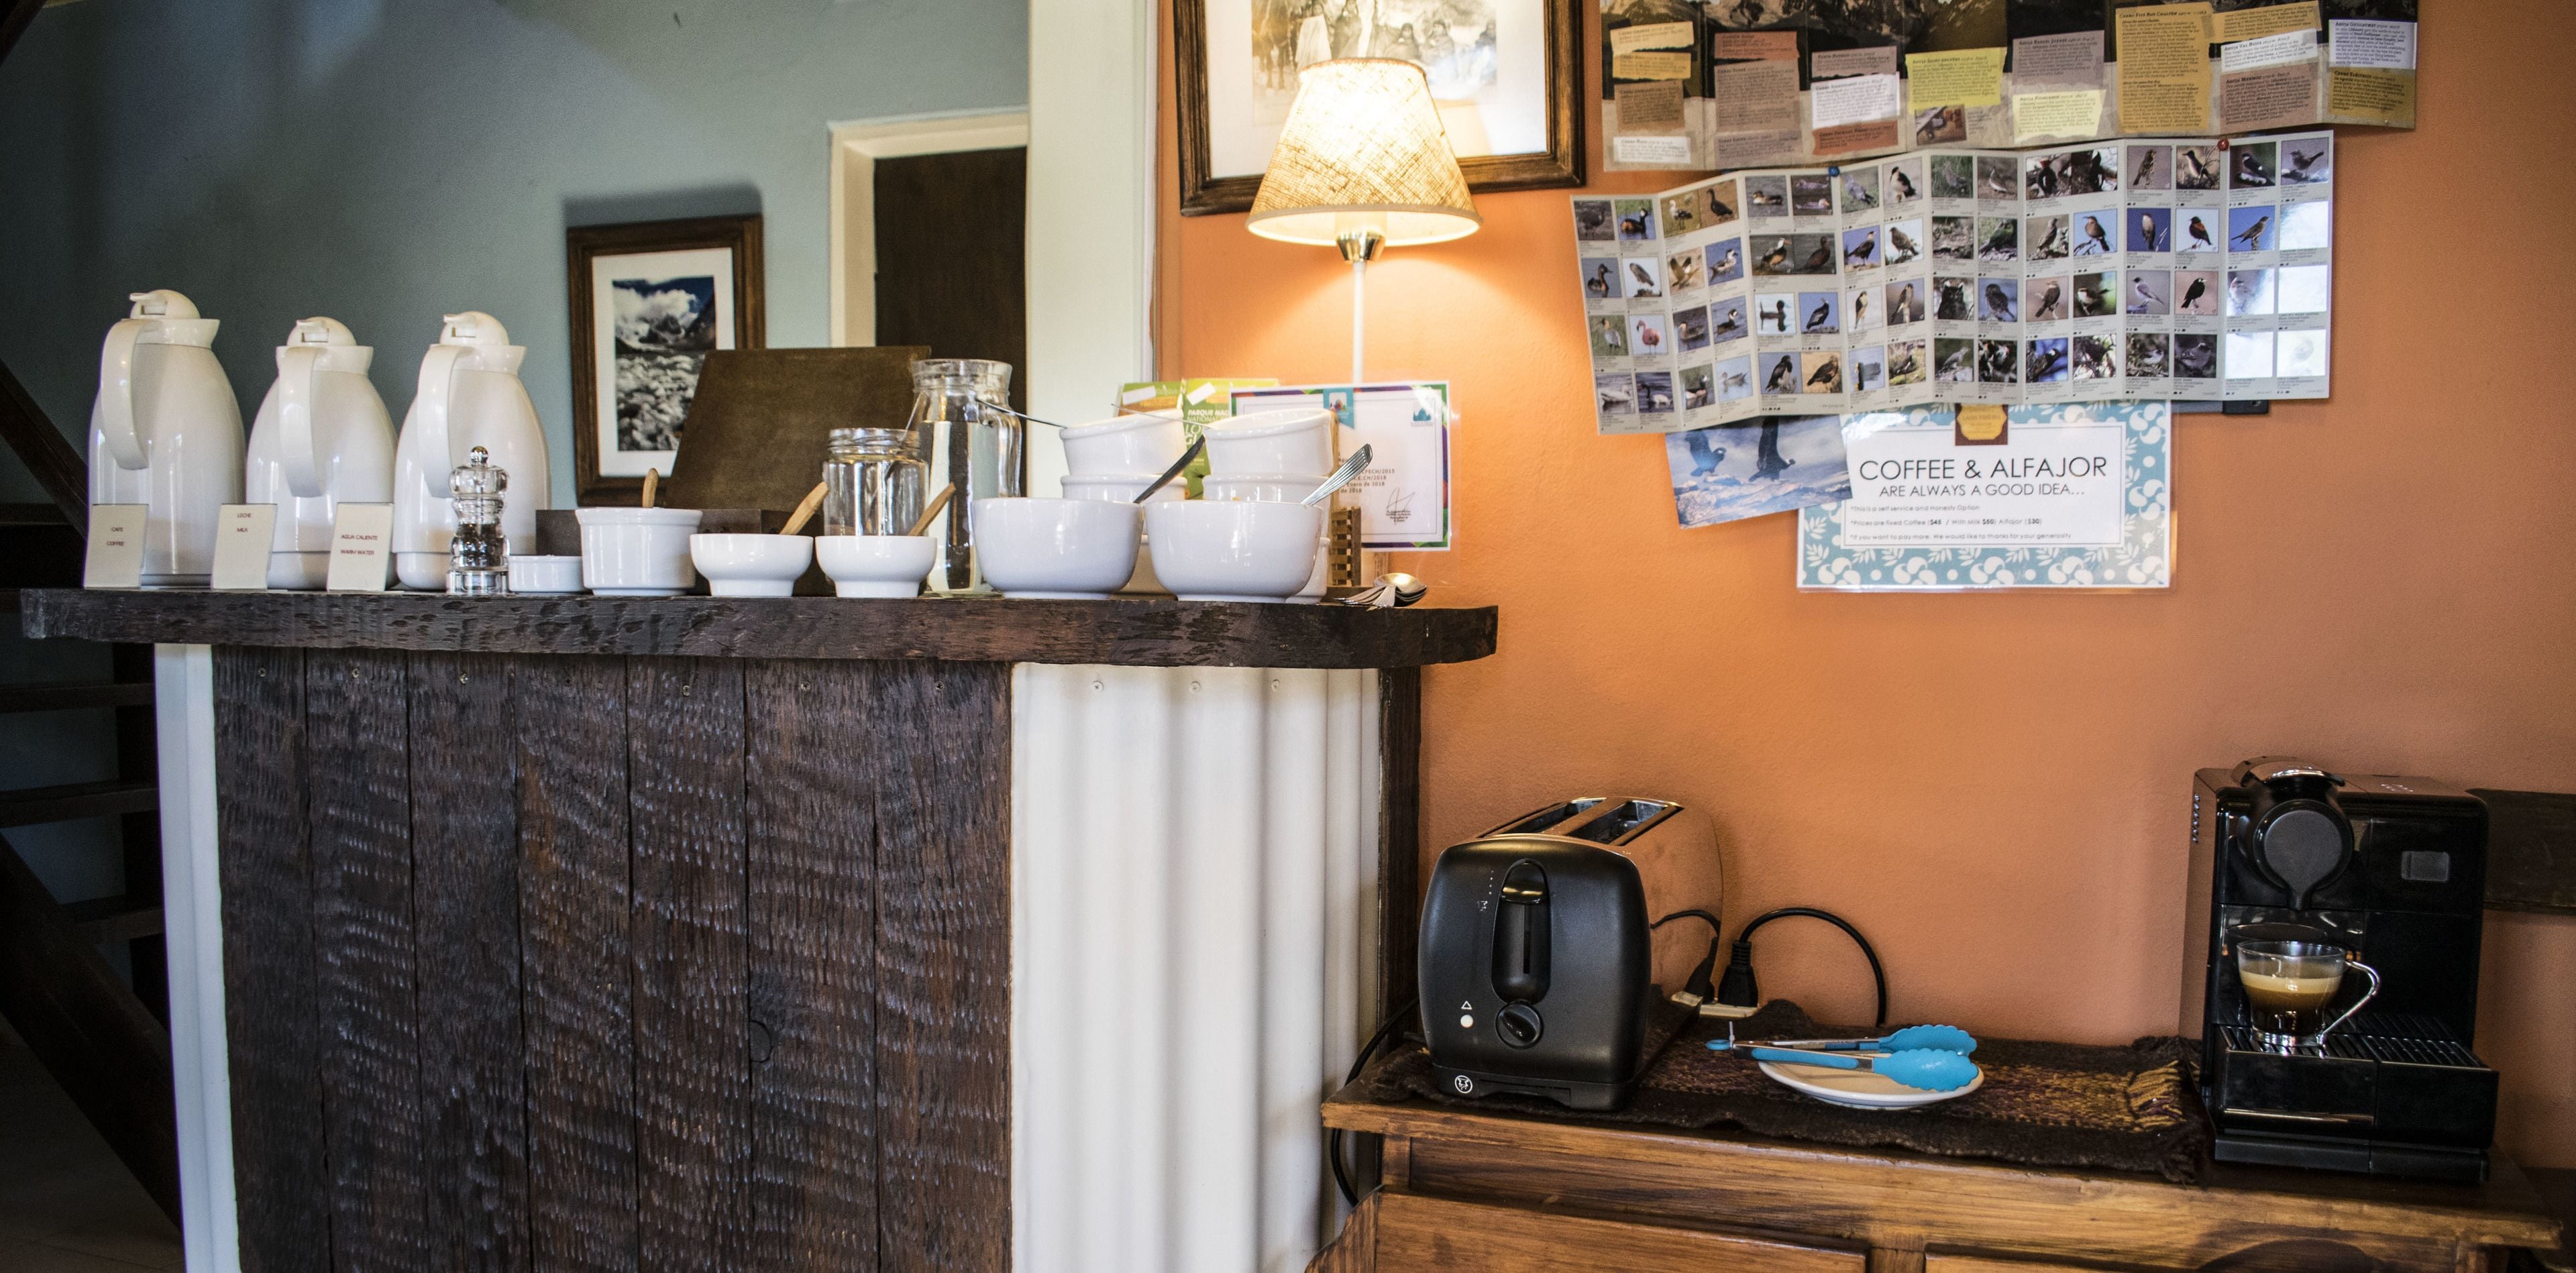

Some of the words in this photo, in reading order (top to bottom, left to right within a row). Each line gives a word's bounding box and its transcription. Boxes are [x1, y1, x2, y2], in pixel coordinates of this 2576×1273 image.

[1185, 423, 1201, 435] LO
[1860, 459, 1955, 480] COFFEE
[1965, 459, 1982, 479] &
[1990, 457, 2107, 478] ALFAJOR
[1880, 486, 1906, 497] ARE
[1909, 484, 1966, 496] ALWAYS
[1972, 485, 1981, 496] A
[1985, 484, 2034, 496] GOOD
[2039, 483, 2084, 495] IDEA...
